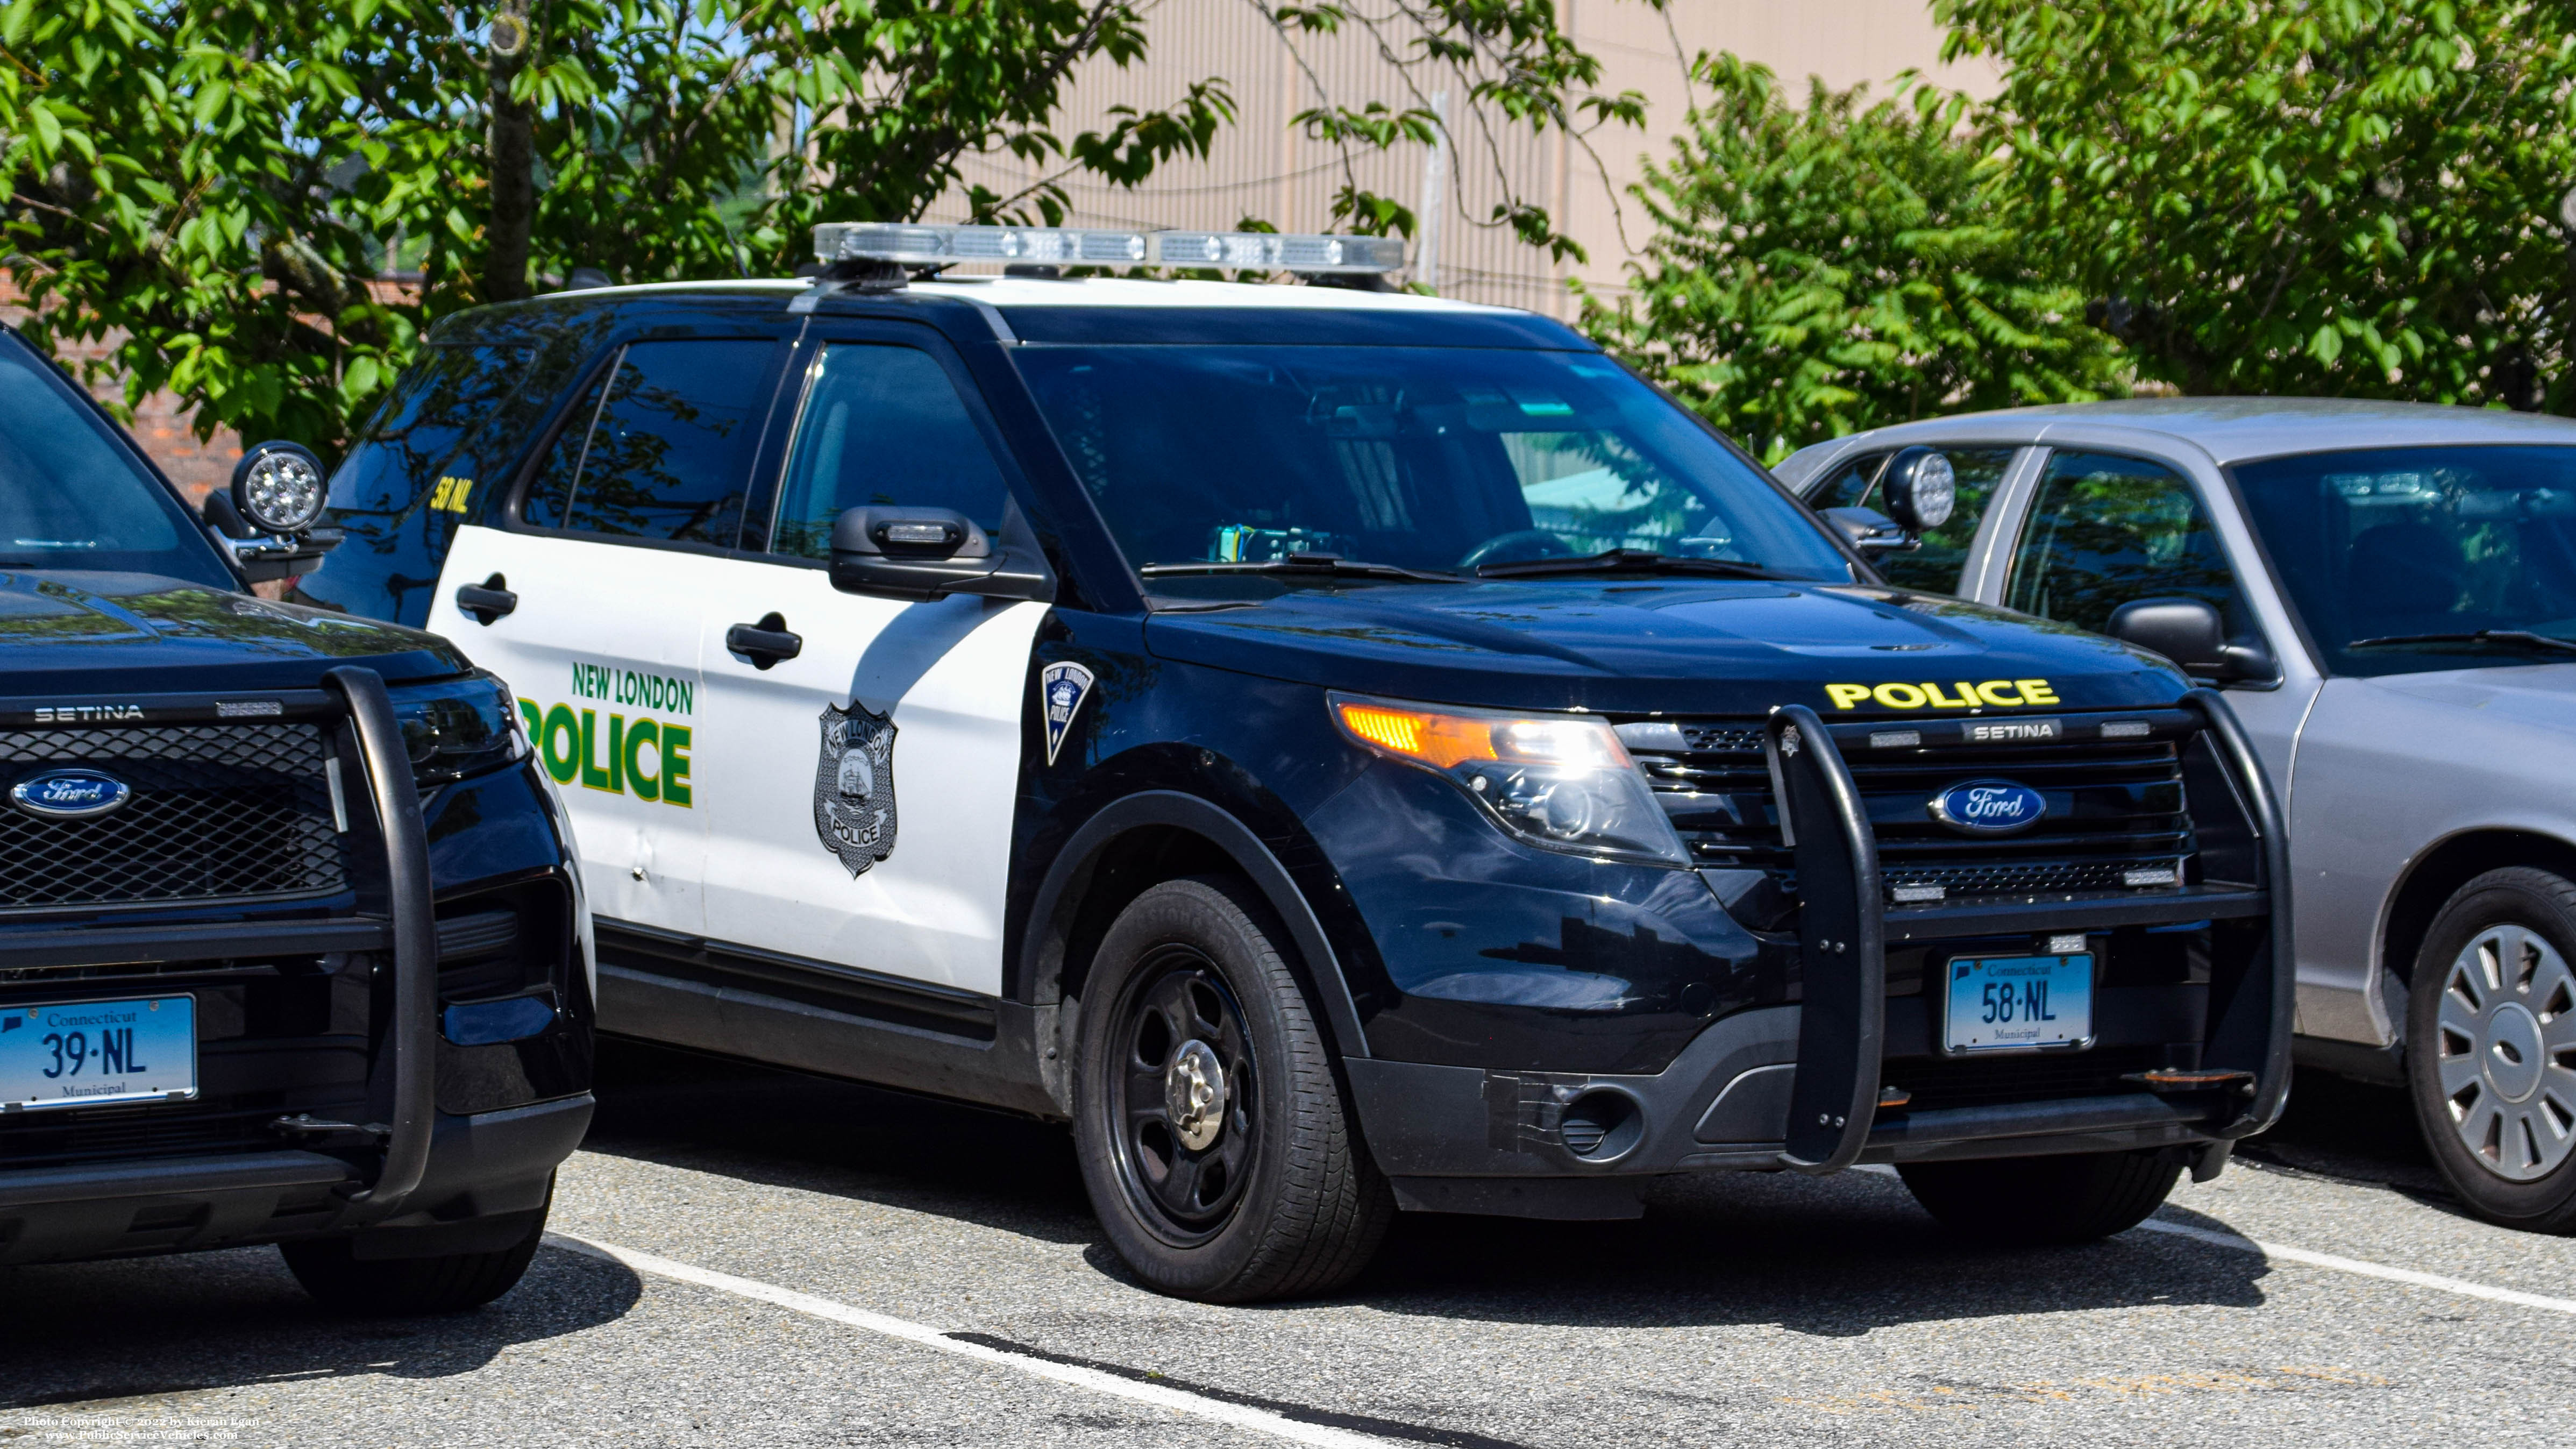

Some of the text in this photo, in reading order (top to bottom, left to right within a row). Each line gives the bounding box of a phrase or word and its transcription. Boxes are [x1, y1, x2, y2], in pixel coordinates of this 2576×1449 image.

[1047, 667, 1090, 690] NEW LONDON
[572, 662, 693, 715] NEW LONDON
[1825, 679, 2060, 709] POLICE
[34, 705, 145, 722] SETINA
[1050, 705, 1070, 722] POLICE
[828, 721, 887, 759] NEW LONDON
[1974, 724, 2054, 740] SETINA
[43, 779, 103, 801] Ford
[1966, 787, 2025, 818] Ford
[833, 819, 879, 844] POLICE
[1988, 965, 2052, 977] Connecticut
[48, 1011, 137, 1027] Connecticut
[1995, 1027, 2041, 1039] Municipal
[62, 1082, 126, 1097] Municipal
